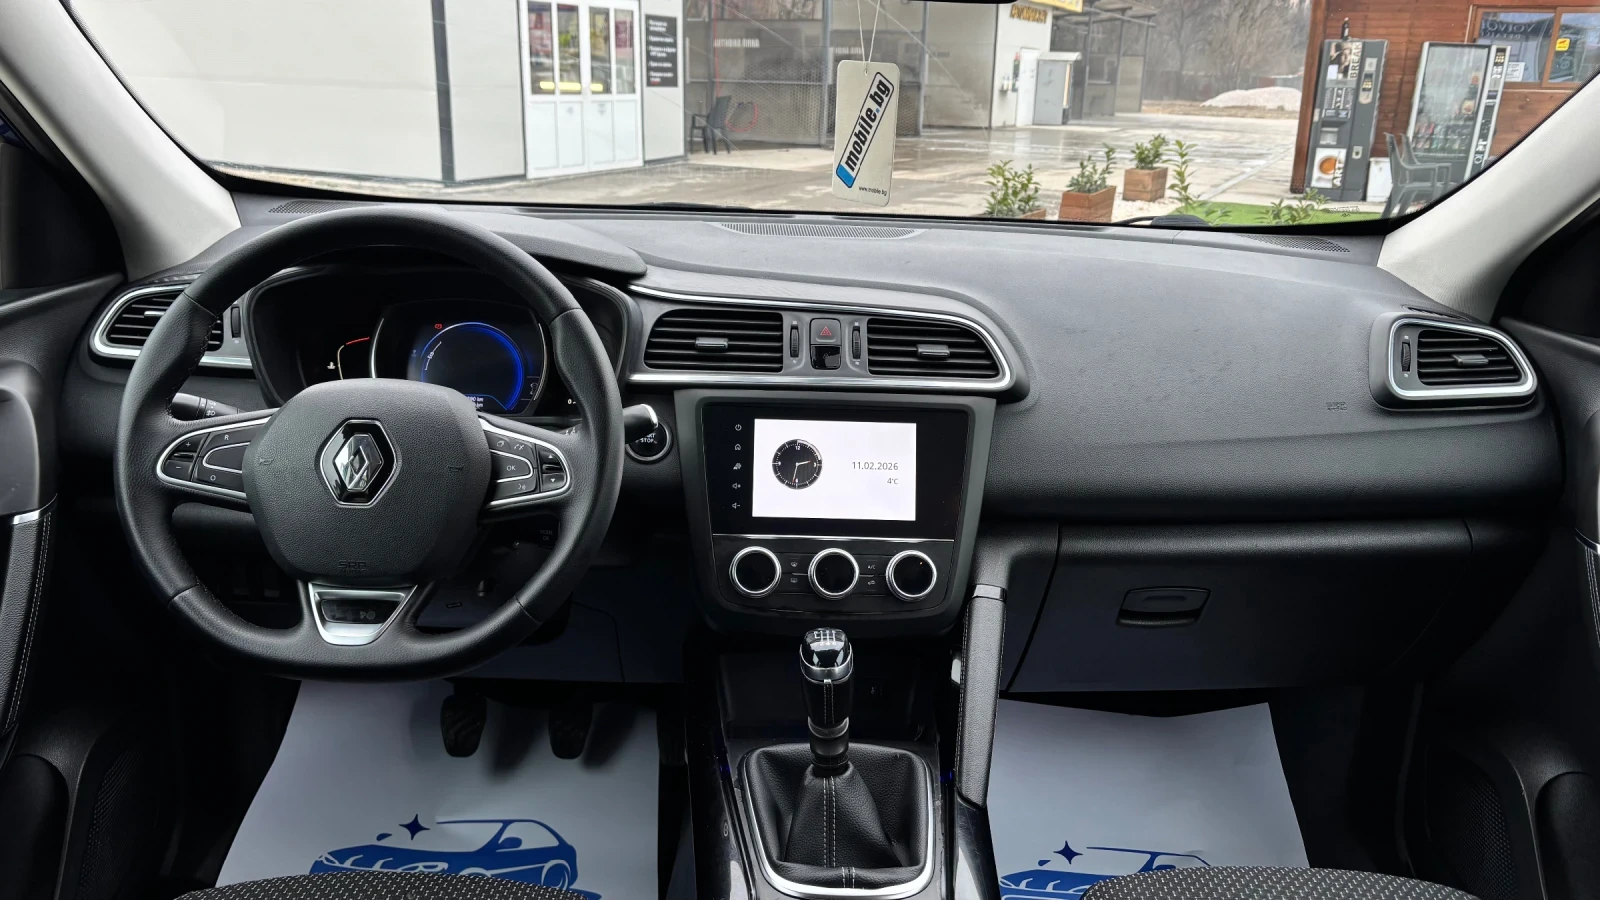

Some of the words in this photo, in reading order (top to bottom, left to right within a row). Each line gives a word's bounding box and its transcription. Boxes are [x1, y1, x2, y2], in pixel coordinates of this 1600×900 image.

[1350, 42, 1362, 79] BREAK
[845, 79, 891, 173] mobile.bg
[852, 461, 899, 471] 11.02.2026
